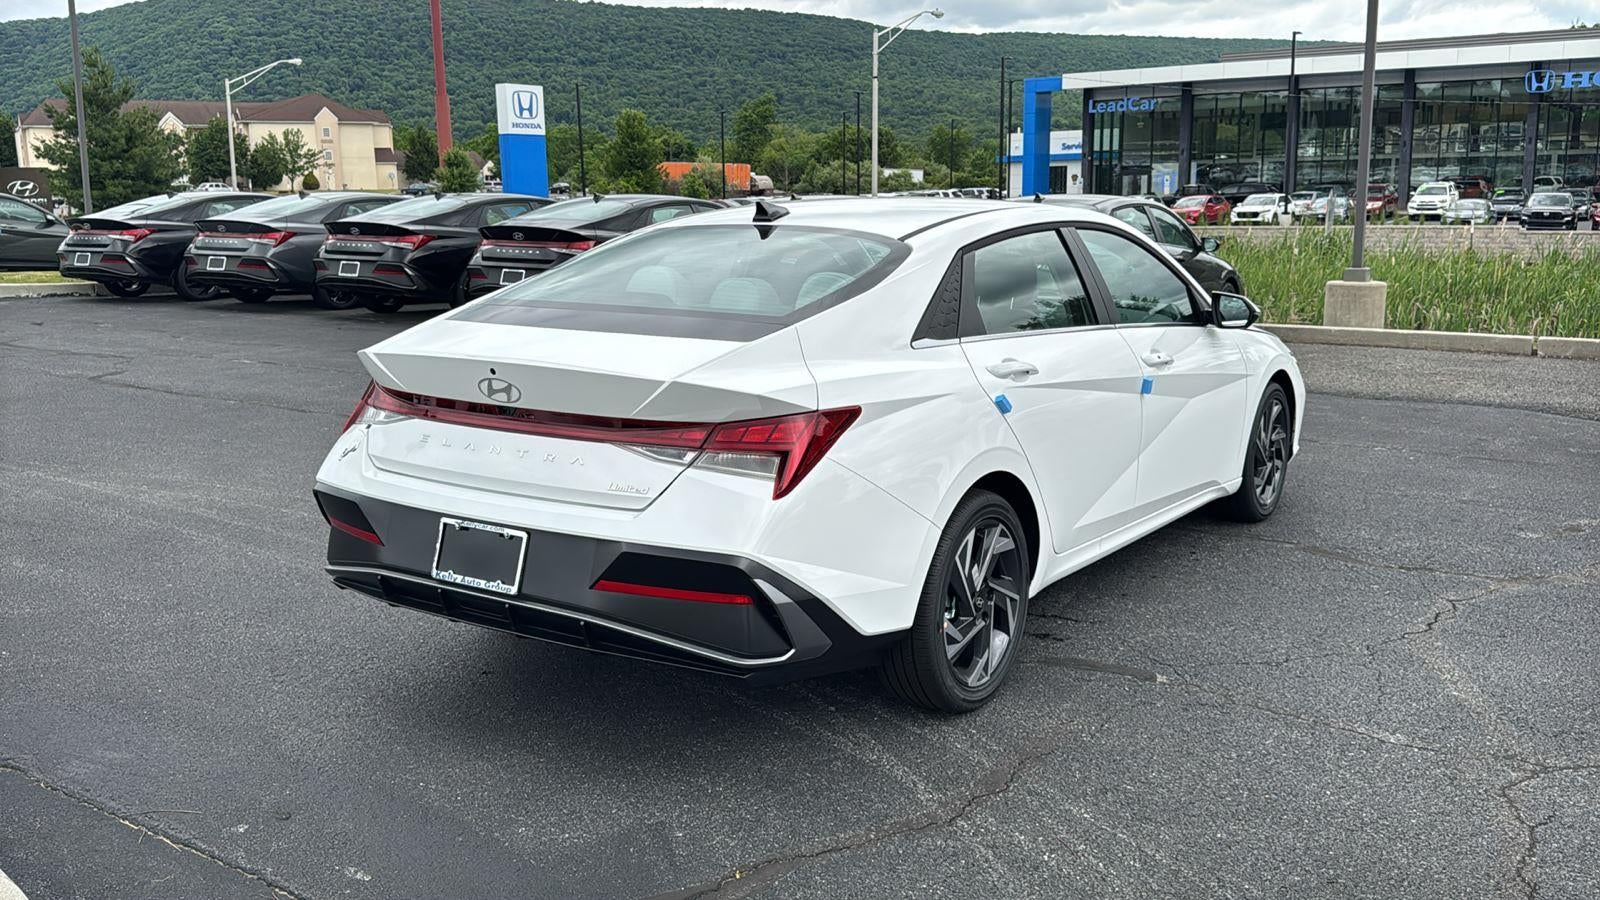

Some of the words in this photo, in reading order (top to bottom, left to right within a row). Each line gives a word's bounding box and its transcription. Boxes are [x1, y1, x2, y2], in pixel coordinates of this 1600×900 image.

[1088, 96, 1158, 114] LeadCar
[511, 122, 543, 130] HONDA
[1061, 141, 1082, 151] Servi
[420, 433, 585, 466] ELANTRA
[607, 480, 650, 495] Limited
[436, 571, 459, 582] Kelly
[460, 576, 482, 587] Auto
[484, 582, 512, 594] Group
